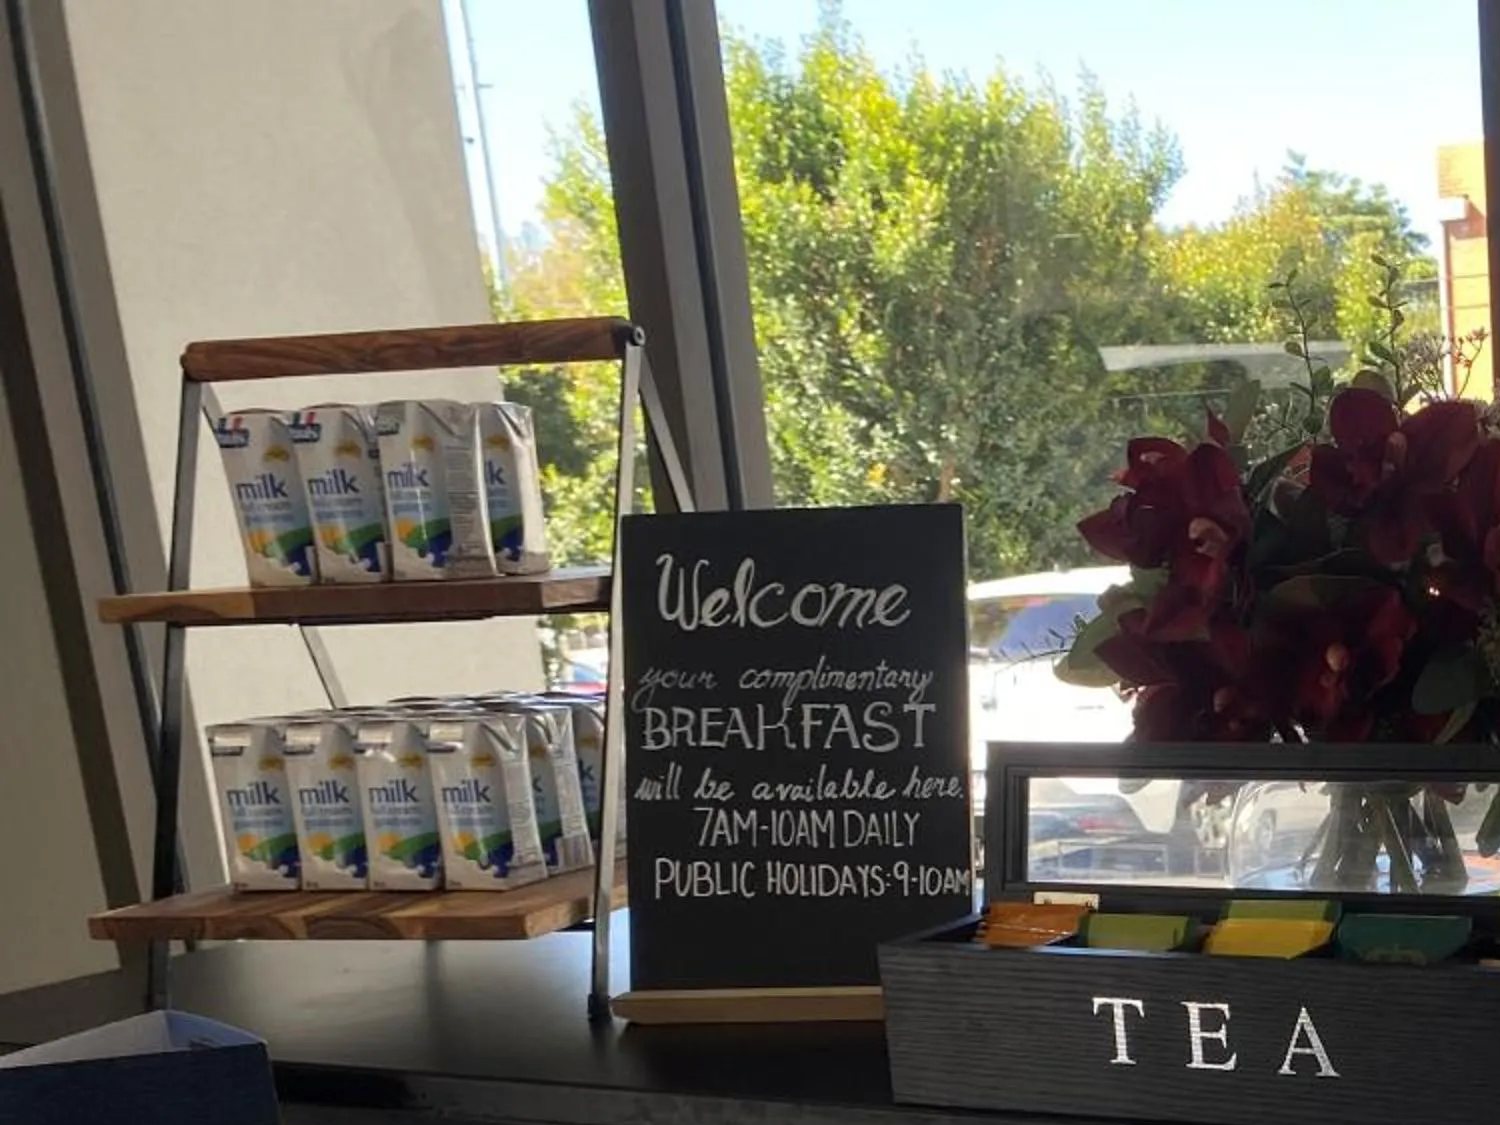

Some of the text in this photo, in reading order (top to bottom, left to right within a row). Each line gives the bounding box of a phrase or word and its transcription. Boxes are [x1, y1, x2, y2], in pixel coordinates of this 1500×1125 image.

[236, 473, 288, 499] milk
[308, 469, 360, 495] milk
[656, 553, 911, 631] Welcome
[632, 655, 933, 711] your complimentary
[641, 701, 936, 752] BREAKFAST
[227, 781, 280, 805] milk
[299, 780, 350, 805] milk
[368, 778, 418, 803] milk
[442, 779, 491, 803] milk
[634, 762, 682, 800] will
[695, 767, 735, 800] be
[752, 765, 896, 801] available
[694, 807, 920, 849] 7AM-10AM DAILY
[655, 858, 755, 899] PUBLIC
[1091, 997, 1341, 1078] TEA
